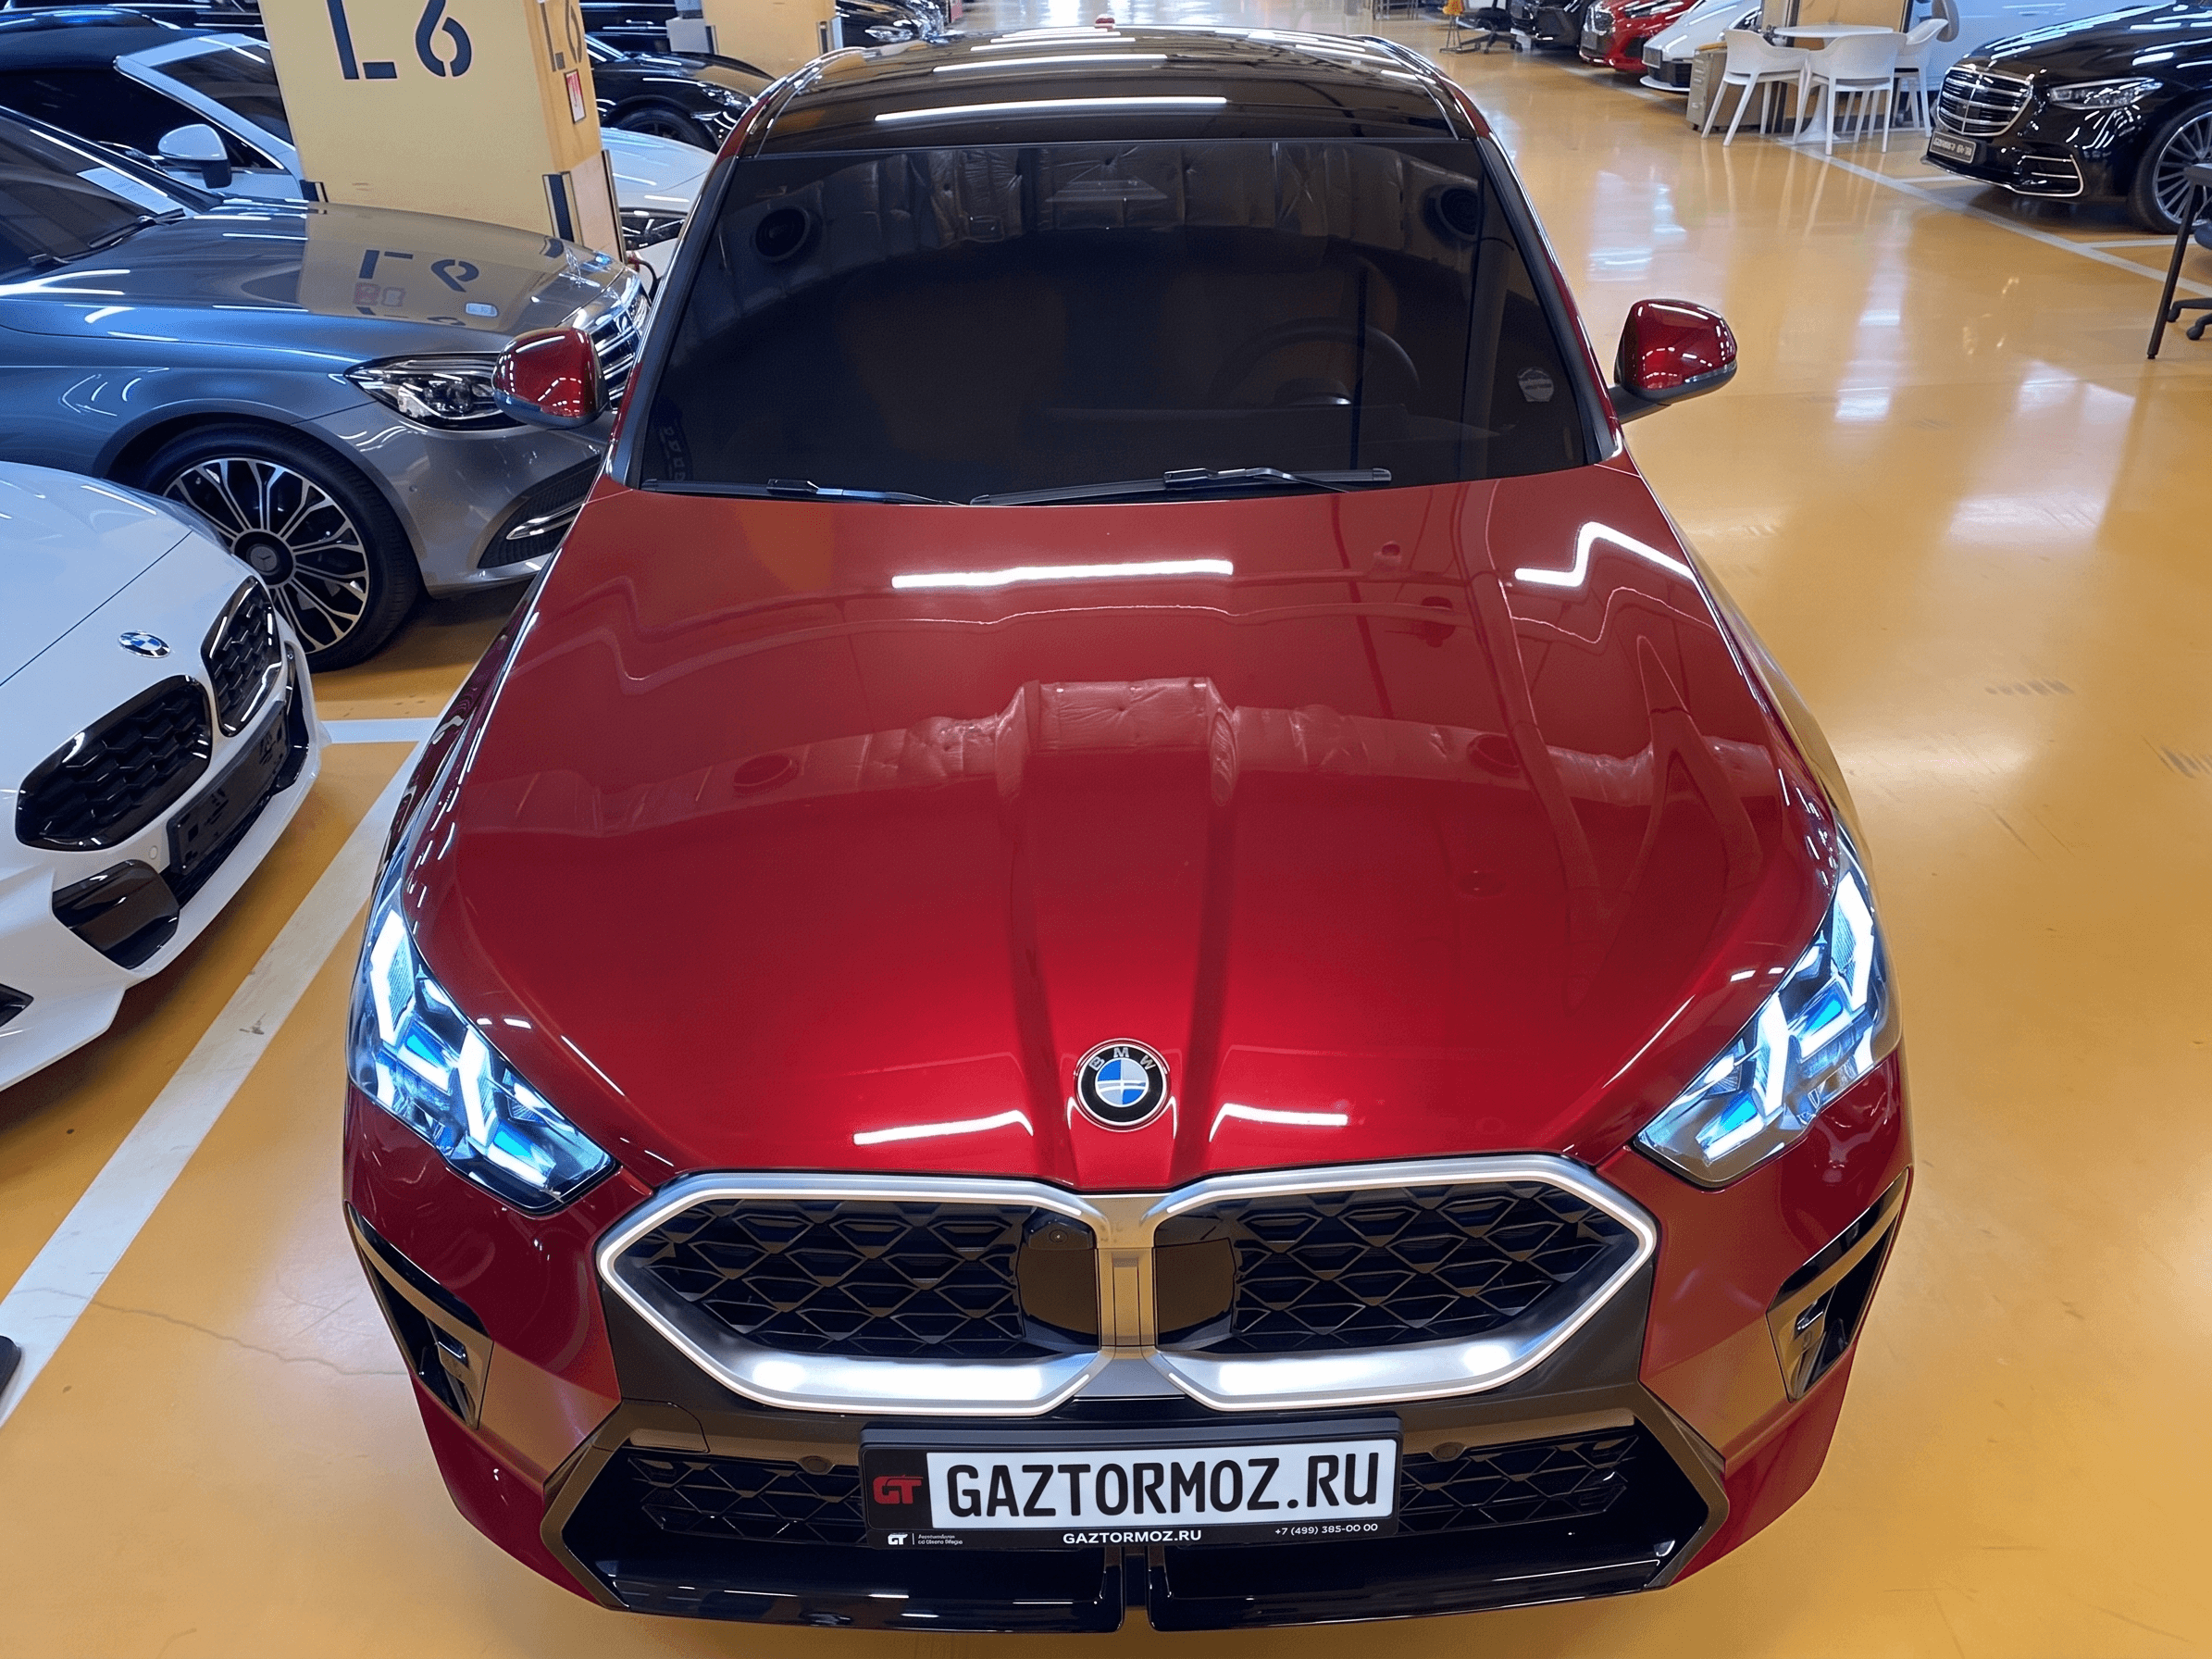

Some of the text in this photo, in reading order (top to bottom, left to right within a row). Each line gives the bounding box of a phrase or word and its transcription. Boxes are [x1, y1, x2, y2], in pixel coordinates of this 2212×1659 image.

[1088, 1047, 1156, 1071] BMW
[873, 1475, 924, 1504] GT
[947, 1453, 1379, 1517] GAZTORMOZ.RU
[888, 1533, 908, 1545] GT
[1063, 1529, 1202, 1544] GAZTORMOZ.RU
[1275, 1523, 1378, 1536] +7 (499) 385-00 00
